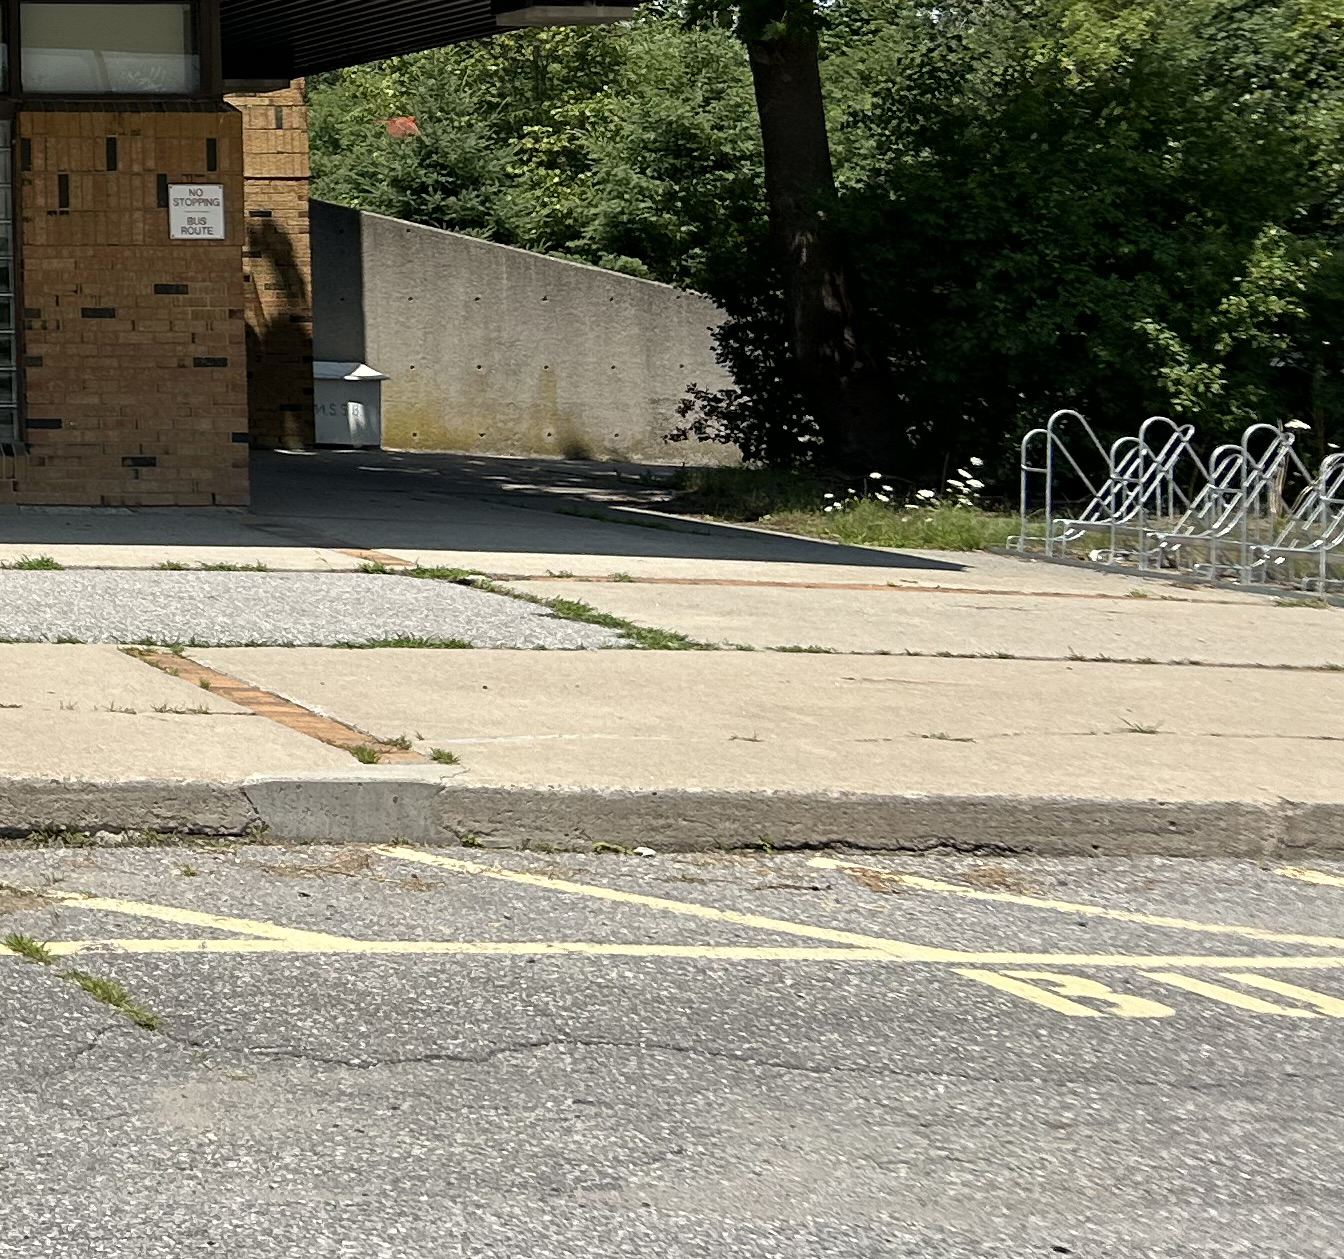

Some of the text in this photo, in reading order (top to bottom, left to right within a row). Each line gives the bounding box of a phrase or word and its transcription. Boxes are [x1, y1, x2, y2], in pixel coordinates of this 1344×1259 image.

[188, 188, 204, 197] NO
[173, 198, 221, 207] STOPPING
[186, 217, 207, 226] BUS
[180, 226, 214, 236] ROUTE
